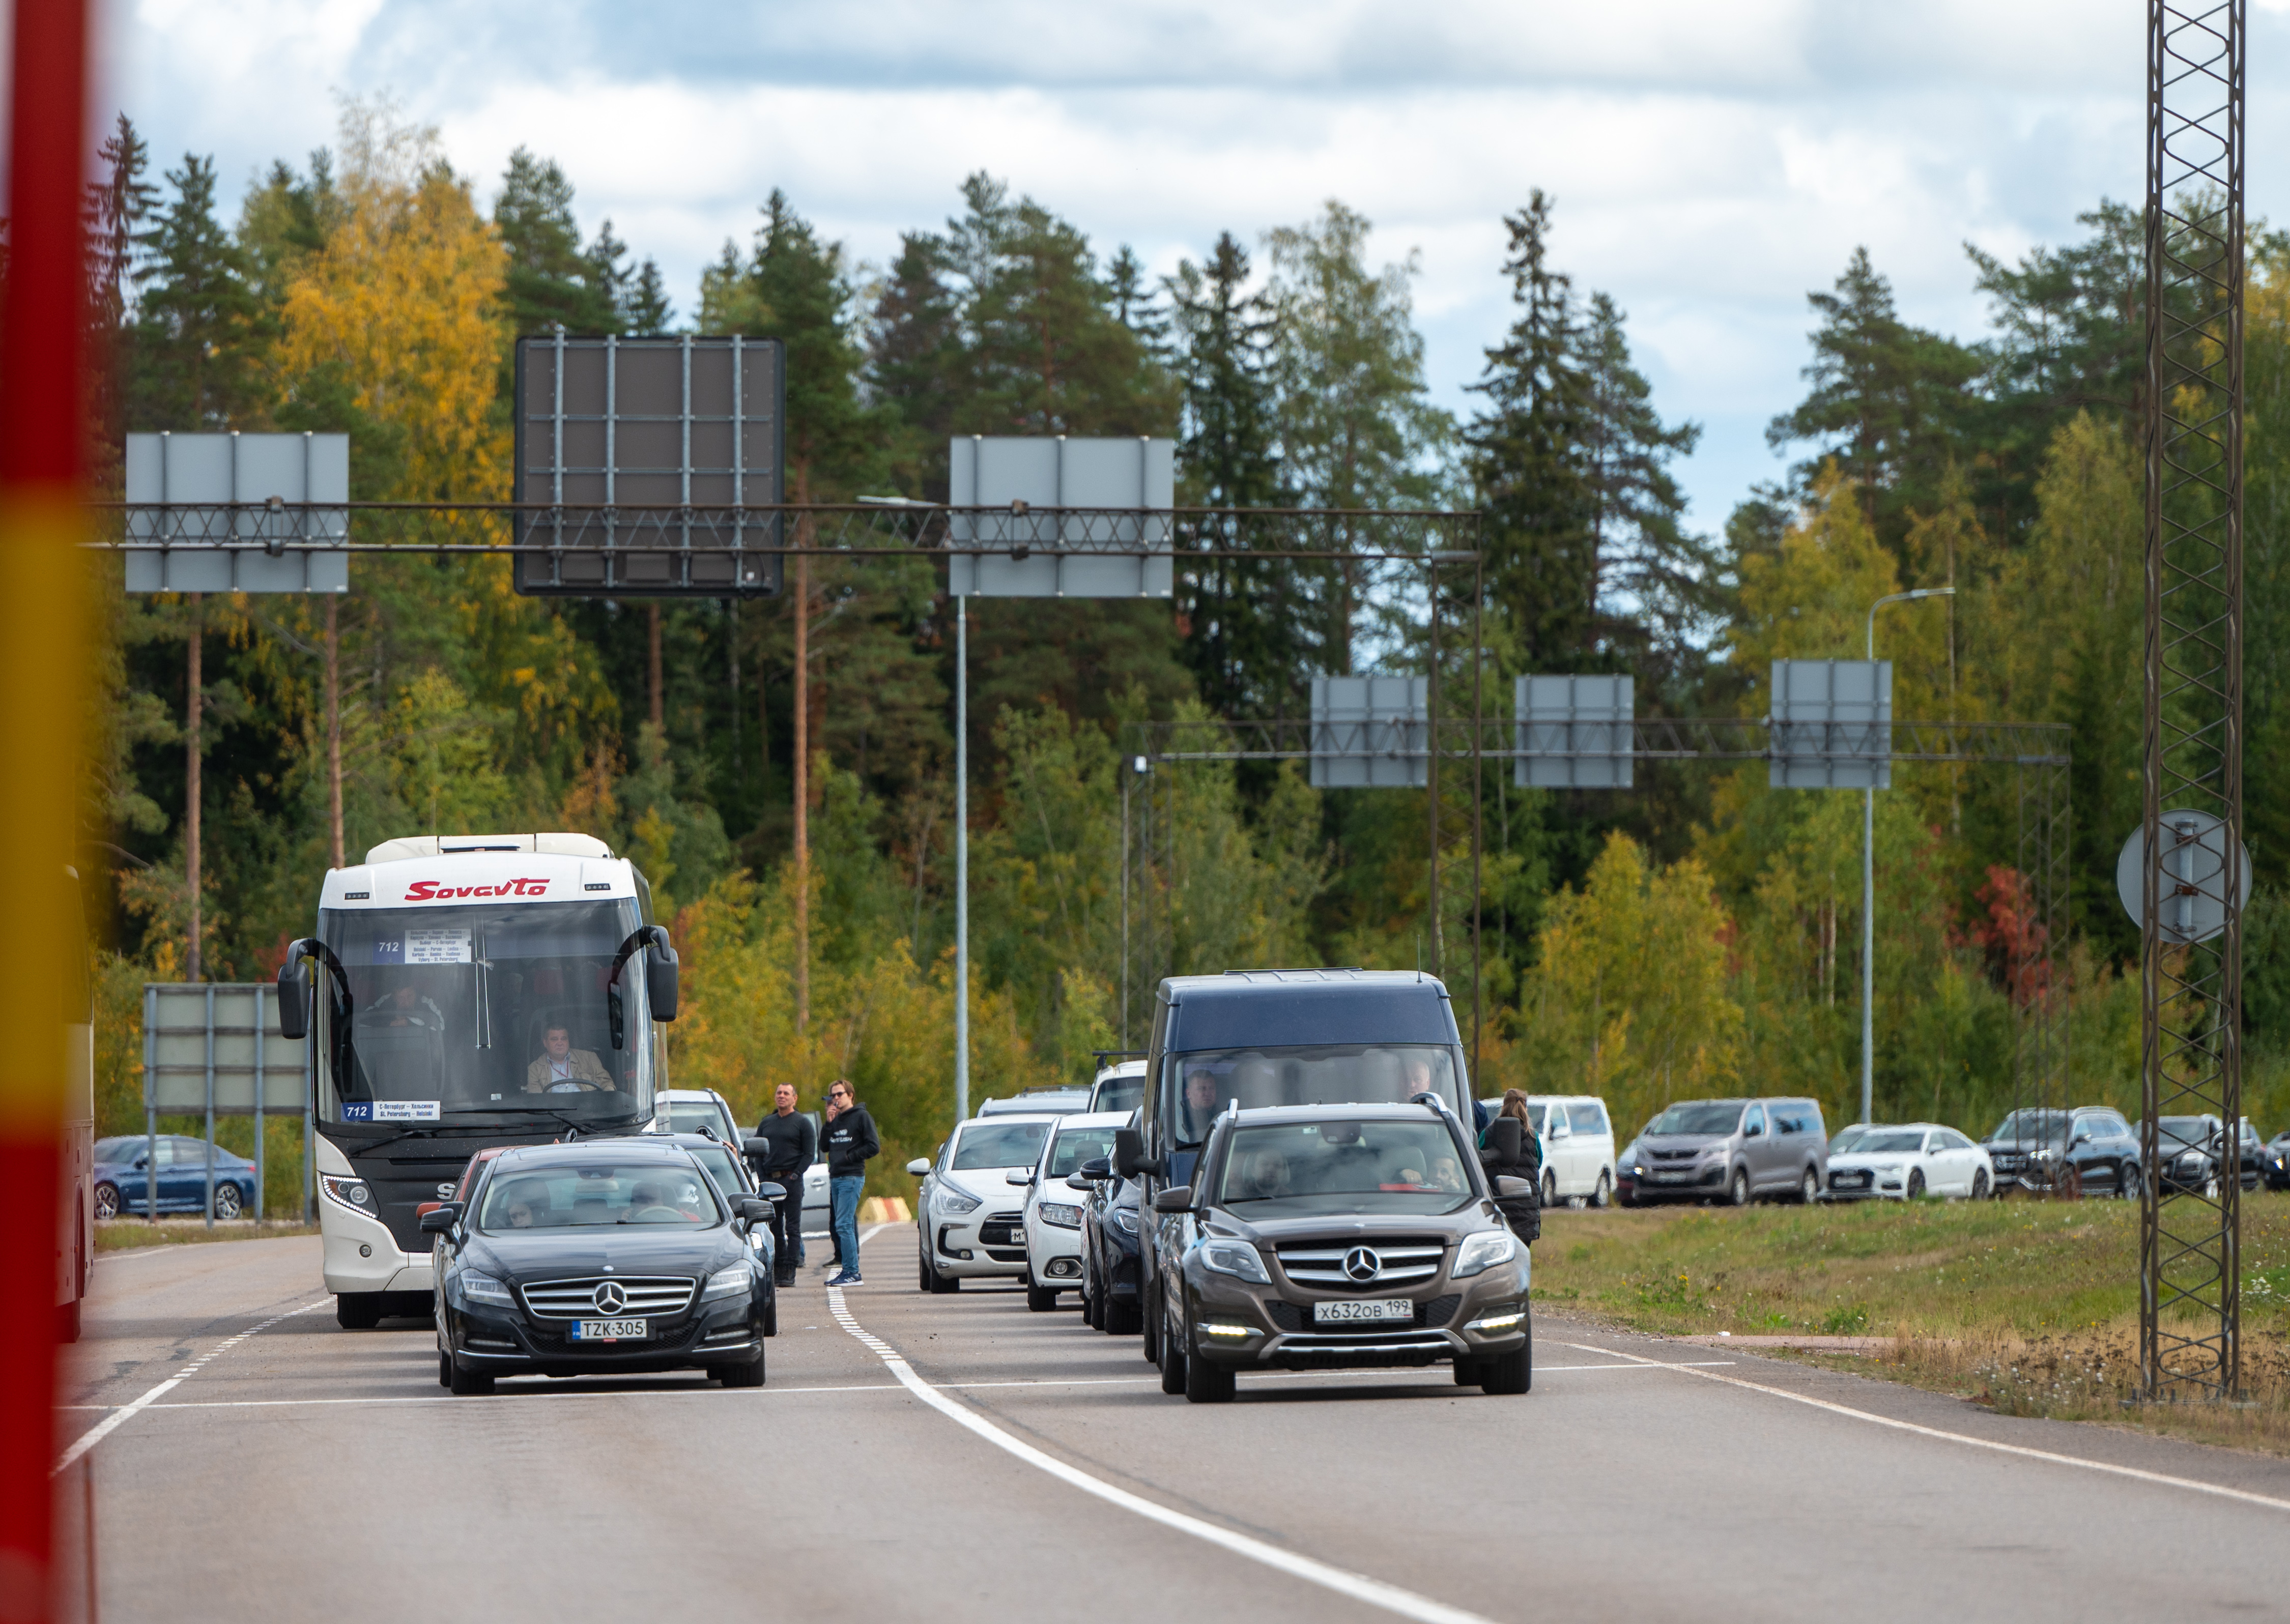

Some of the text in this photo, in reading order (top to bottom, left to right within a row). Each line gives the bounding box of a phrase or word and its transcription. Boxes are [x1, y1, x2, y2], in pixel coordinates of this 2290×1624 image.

[404, 878, 551, 901] Sovavto
[379, 942, 399, 952] 712
[347, 1107, 367, 1117] 712
[1386, 1300, 1408, 1312] 199
[584, 1322, 644, 1336] TZK-305
